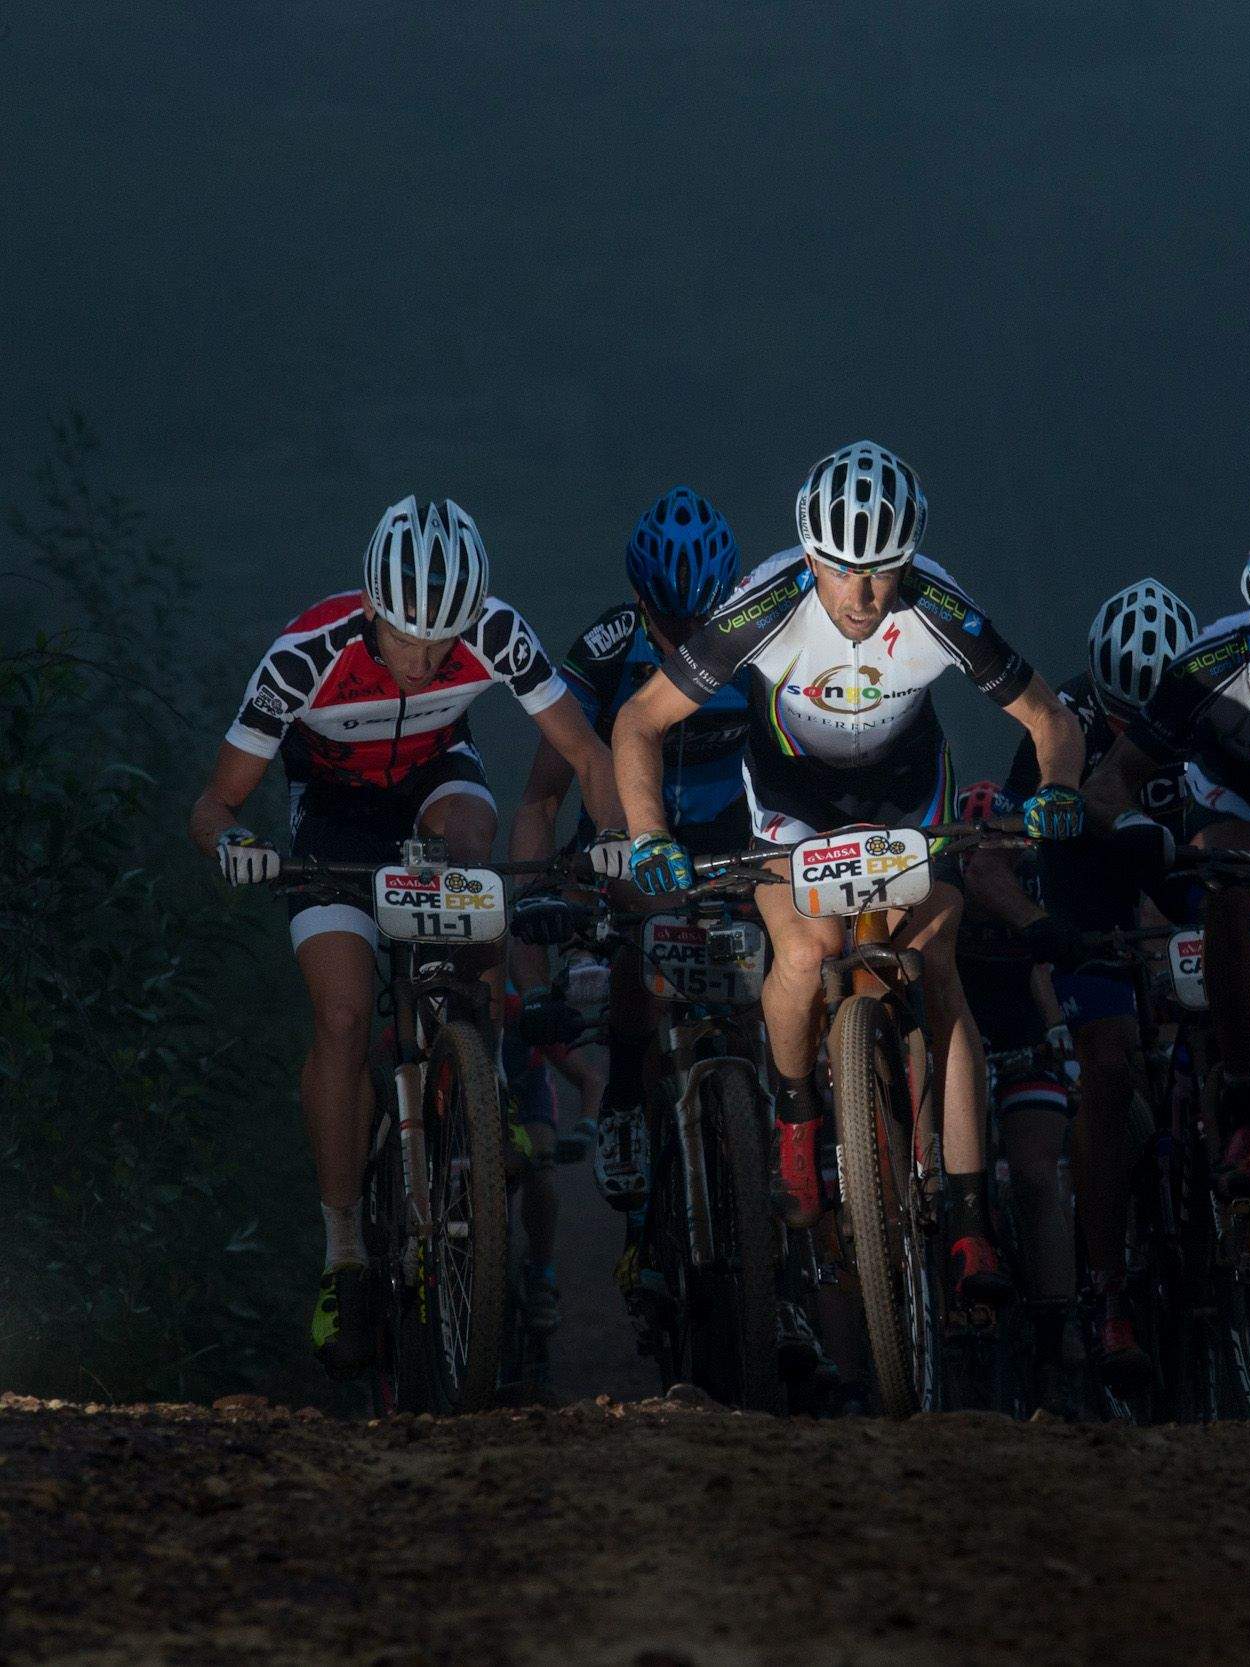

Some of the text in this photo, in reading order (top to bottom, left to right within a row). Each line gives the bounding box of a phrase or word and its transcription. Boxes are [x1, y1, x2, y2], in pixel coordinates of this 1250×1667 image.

[718, 580, 800, 634] velocity
[803, 855, 919, 882] CAPE EPIC
[385, 891, 495, 910] CAPE EPIC
[840, 878, 888, 907] 1-1
[411, 912, 472, 938] 11-1
[653, 944, 706, 964] CAPE
